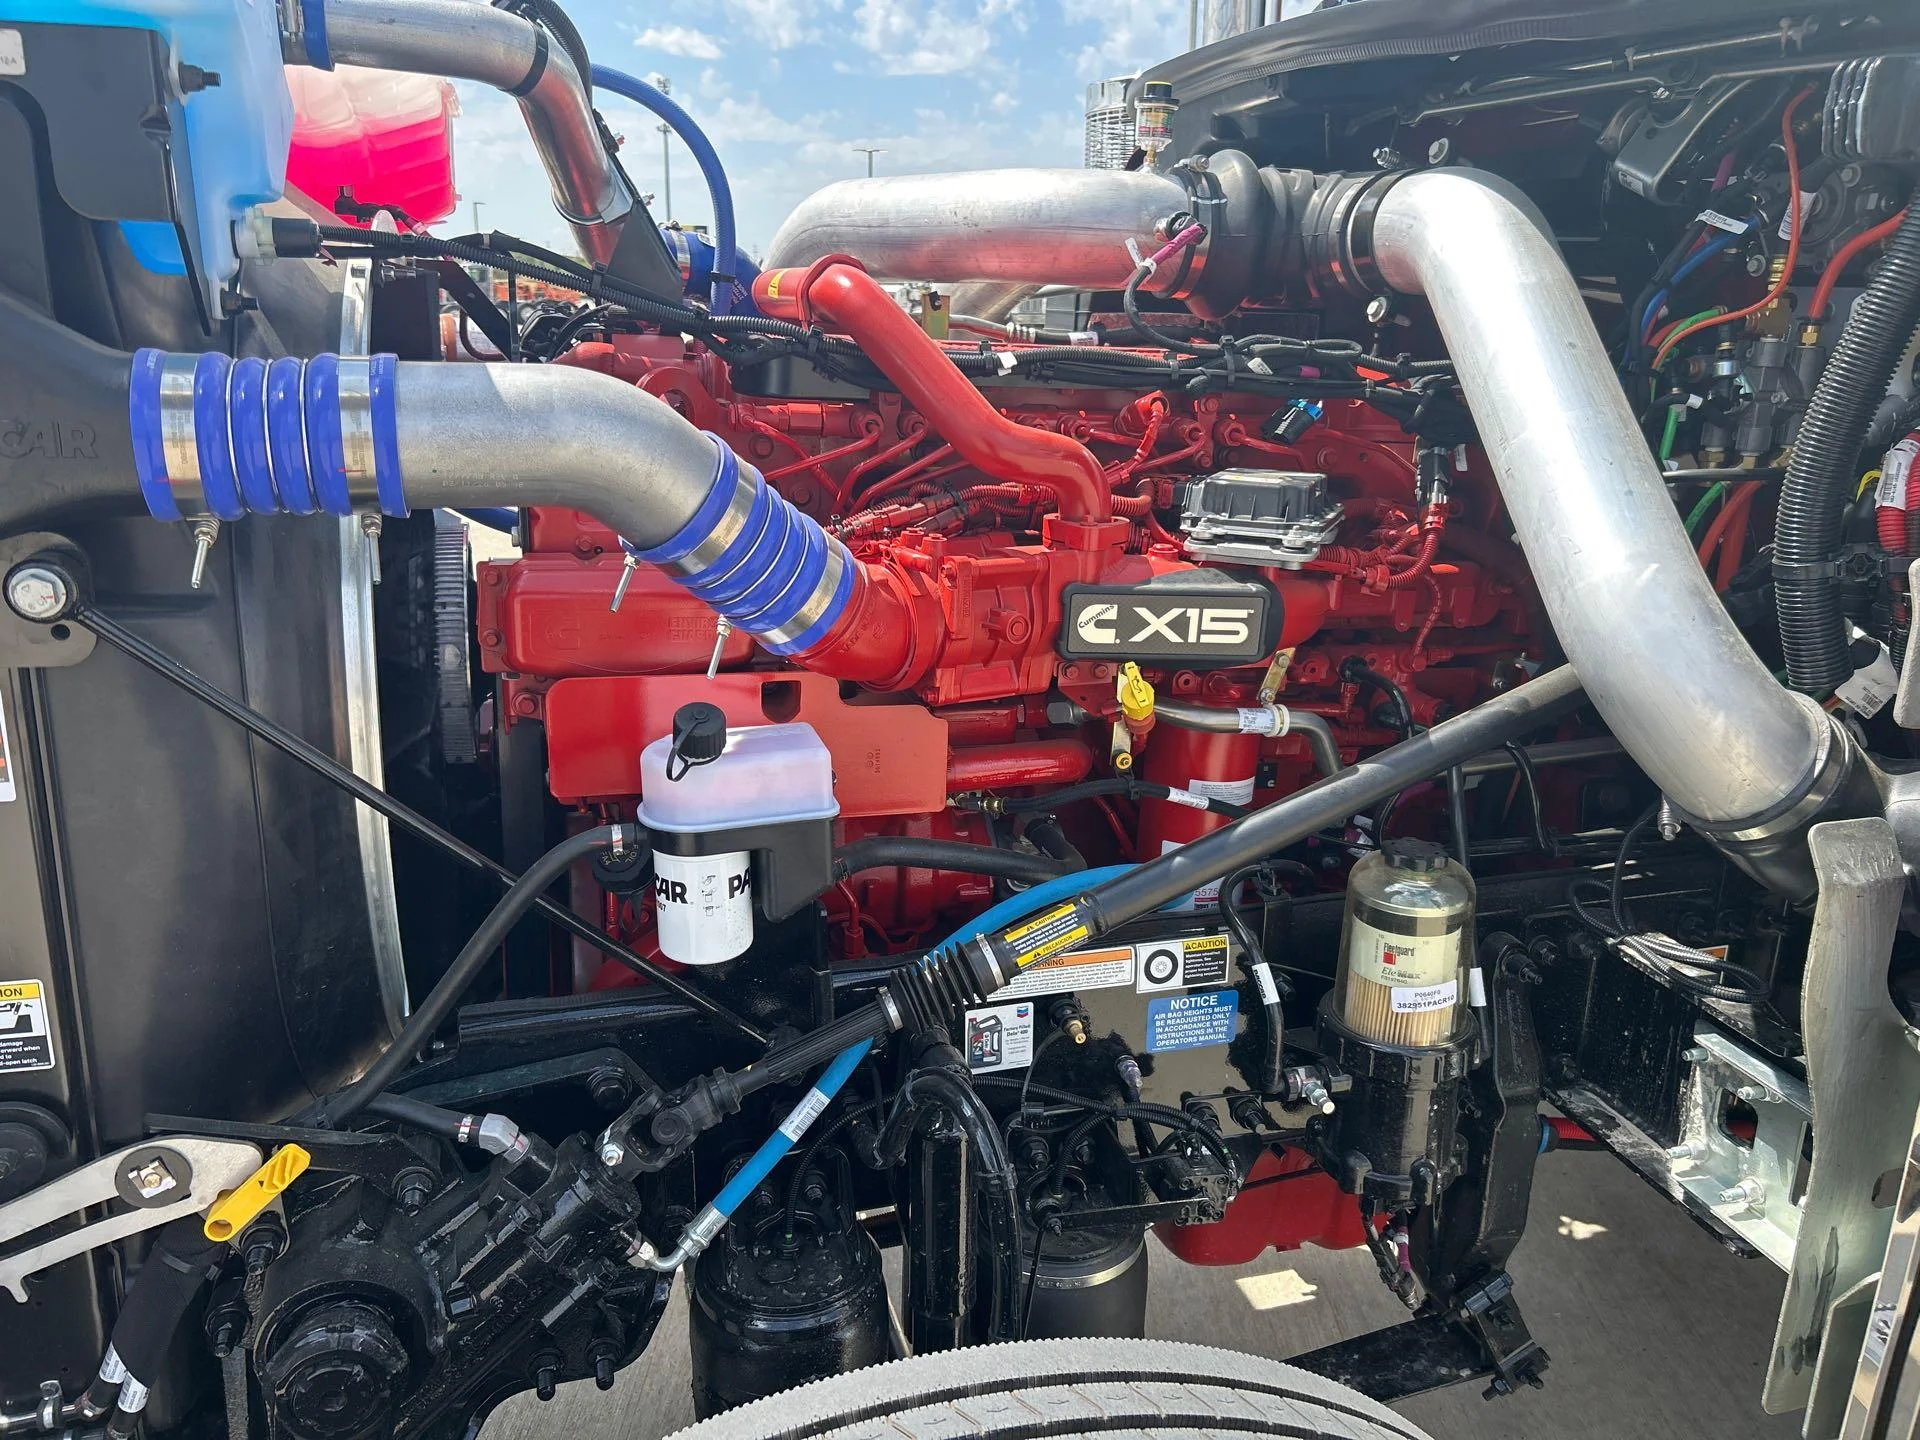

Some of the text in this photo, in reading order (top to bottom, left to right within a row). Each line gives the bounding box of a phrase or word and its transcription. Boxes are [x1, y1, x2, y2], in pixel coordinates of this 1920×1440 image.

[1078, 604, 1249, 644] Cummins X15
[1034, 914, 1056, 927] CAUTION
[1191, 939, 1226, 950] CAUTION
[1384, 942, 1415, 957] Fleetguard
[1170, 995, 1218, 1010] NOTICE
[1183, 1007, 1213, 1016] HEIGHTS
[1166, 1014, 1211, 1025] READJUSTED
[1212, 1012, 1231, 1020] ONLY
[1164, 1021, 1211, 1033] ACCORDANCE
[1155, 1028, 1205, 1040] INSTRUCTIONS
[1156, 1036, 1198, 1047] OPERATORS
[1199, 1033, 1227, 1041] MANUAL
